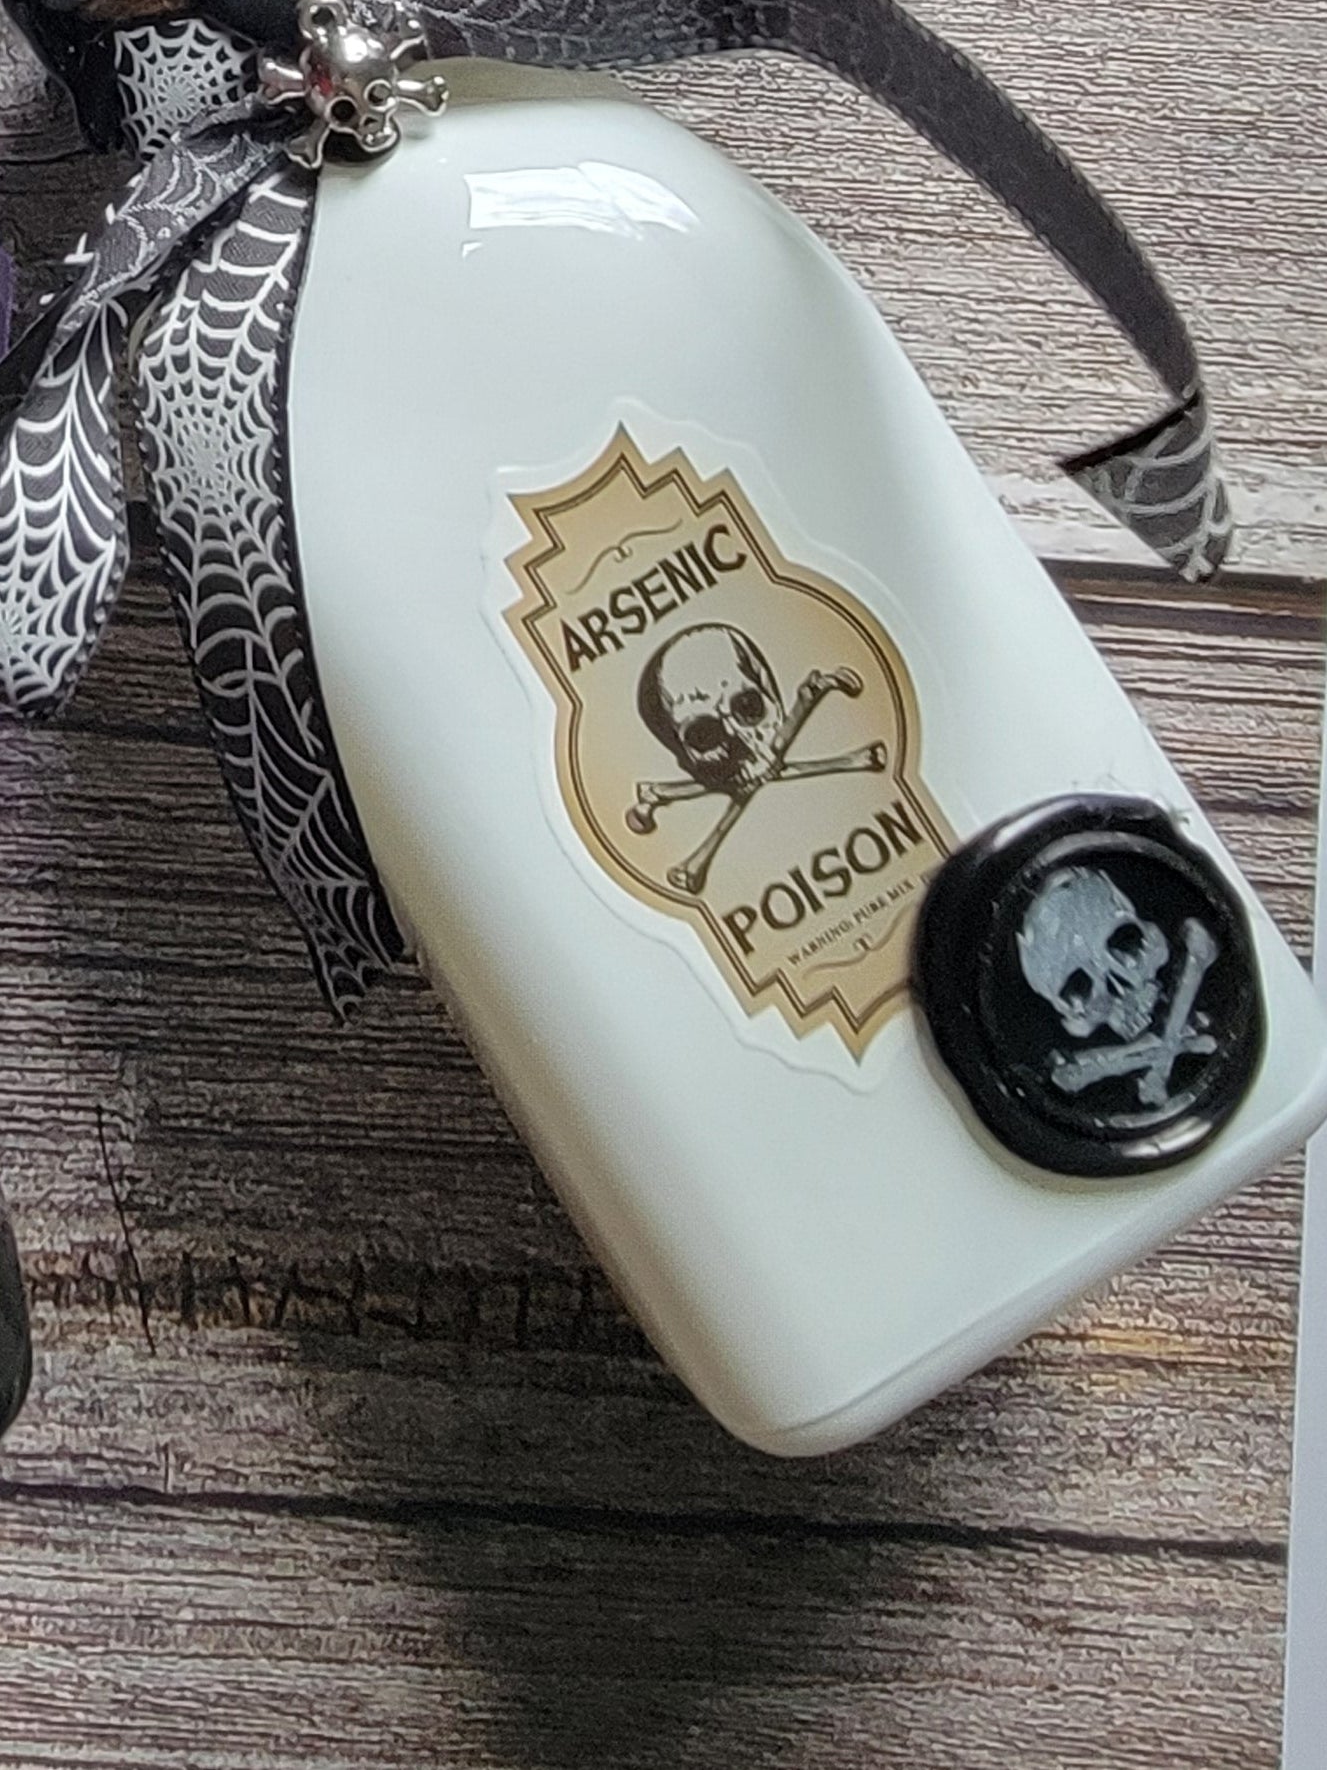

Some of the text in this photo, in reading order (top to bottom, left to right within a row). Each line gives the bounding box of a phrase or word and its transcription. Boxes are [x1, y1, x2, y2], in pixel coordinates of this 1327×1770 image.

[558, 523, 748, 672] ARSENIC
[723, 801, 925, 957] POISON
[852, 895, 888, 924] PURE
[885, 879, 916, 902] MIX
